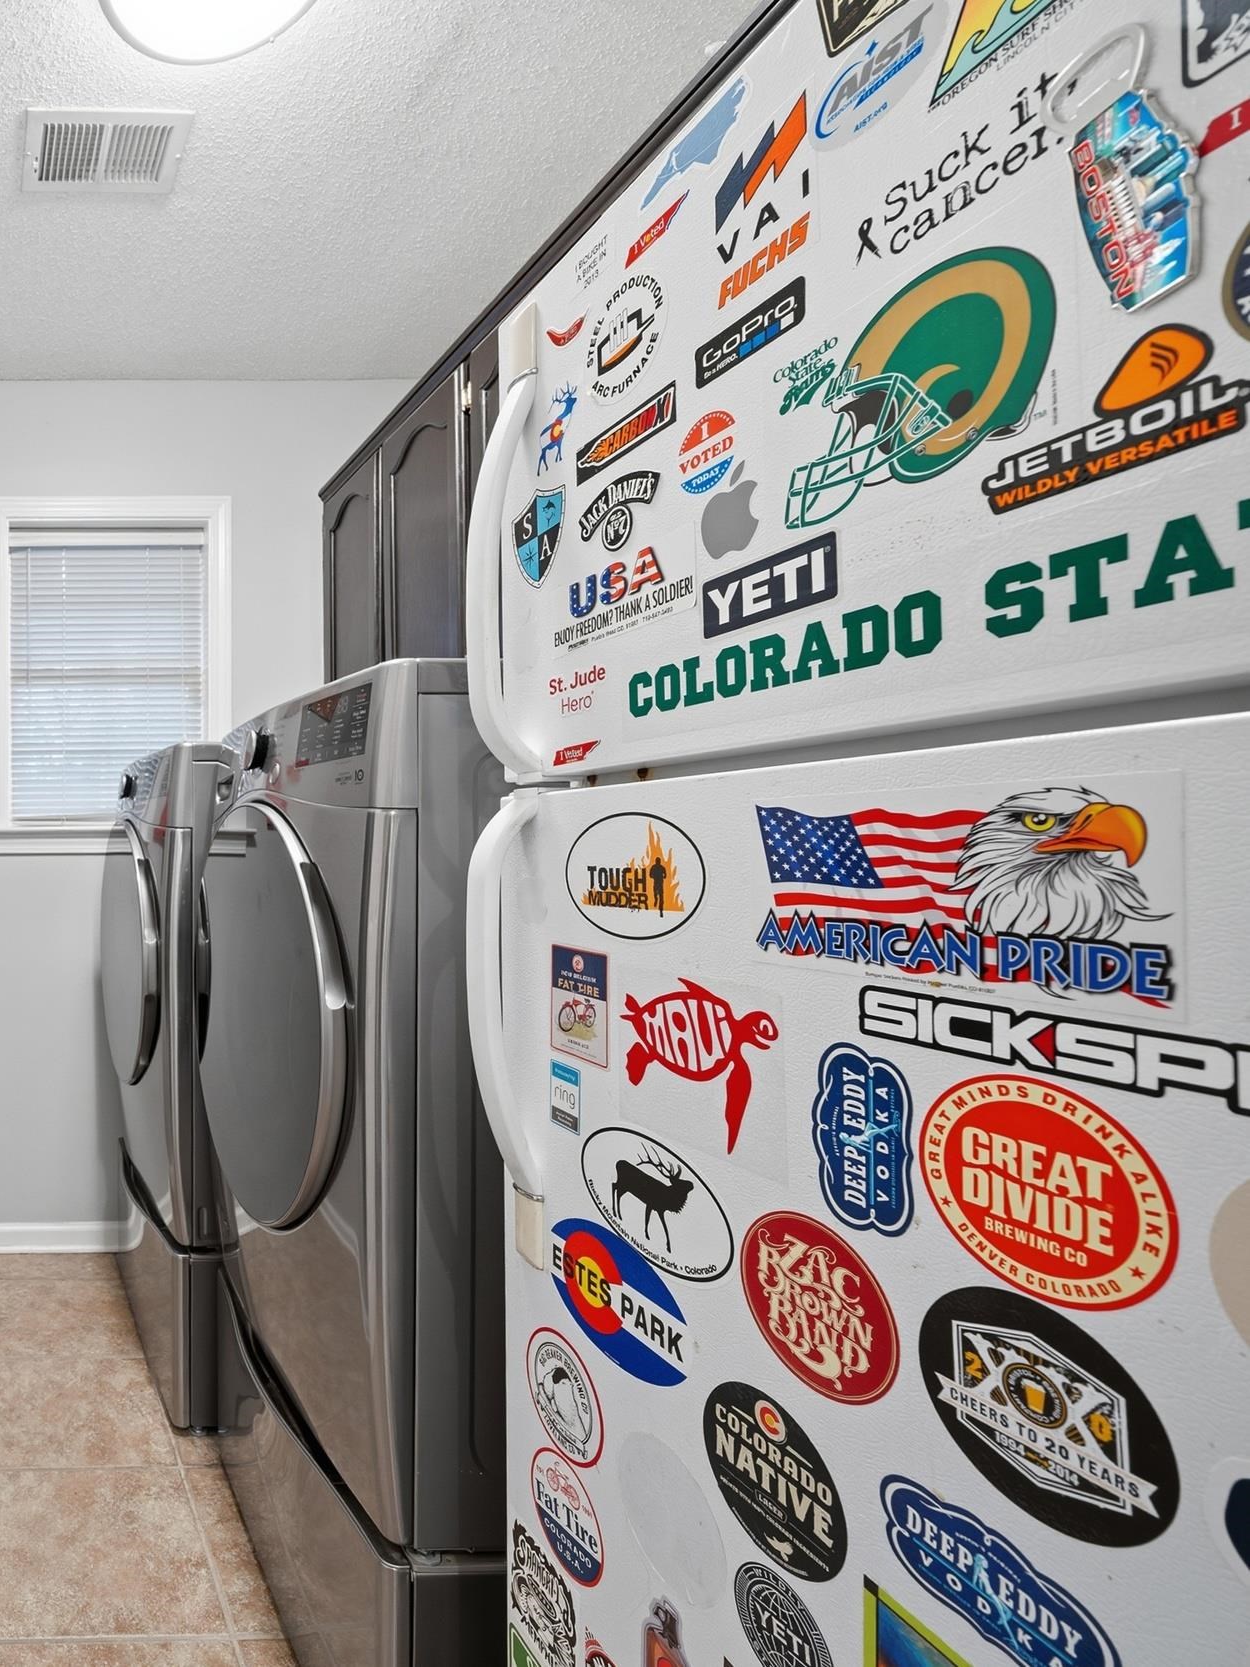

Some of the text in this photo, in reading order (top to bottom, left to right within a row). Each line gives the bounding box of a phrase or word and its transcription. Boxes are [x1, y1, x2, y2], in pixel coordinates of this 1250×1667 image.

[941, 53, 999, 106] OREGON
[1000, 15, 1040, 57] SURF
[996, 0, 1084, 72] LINCOLN CIT
[883, 123, 990, 226] Suck
[889, 125, 1065, 255] cancer.
[640, 217, 665, 248] Voted
[1071, 139, 1135, 300] BOSTON
[717, 211, 811, 310] FUCHS
[587, 274, 663, 369] STEEL PRODUCTION
[702, 296, 796, 368] GoPro
[592, 380, 610, 398] ARC
[611, 332, 660, 397] FURNACE
[773, 336, 838, 383] Colorado
[788, 357, 823, 388] State
[679, 435, 734, 475] VOTED
[700, 421, 710, 440] I
[987, 382, 1240, 489] JETBOIL
[994, 408, 1238, 508] WILDLY VERSATILE
[691, 465, 722, 488] TODAY
[522, 512, 533, 540] S
[540, 534, 553, 560] A
[579, 495, 609, 538] JACK
[554, 624, 575, 648] ENJOY
[575, 609, 614, 640] FREEDOM?
[614, 600, 643, 624] THANK
[644, 596, 652, 612] A
[652, 575, 694, 608] SOLDIER!
[569, 546, 664, 618] USA
[628, 499, 1250, 718] COLORADO STA
[707, 547, 826, 625] YETI
[549, 665, 606, 695] St. Jude
[561, 693, 593, 714] Hero
[587, 865, 647, 893] TOUGH
[588, 890, 649, 911] MUDDER
[558, 977, 600, 998] FAT TIRE
[755, 909, 1174, 1000] AMERICAN PRIDE
[864, 989, 1250, 1109] SICKSP
[554, 1084, 576, 1110] ring
[842, 1066, 866, 1208] DEEP EDDY
[875, 1086, 890, 1203] VODKA
[928, 1109, 952, 1180] GREAT
[951, 1084, 1030, 1111] MINDS
[1042, 1091, 1134, 1160] DRINK
[1129, 1170, 1164, 1258] ALIKE
[961, 1126, 1114, 1201] GREAT
[602, 1205, 630, 1240] Mountain
[630, 1236, 660, 1261] National
[660, 1256, 679, 1271] Park
[684, 1263, 717, 1276] Colorado
[961, 1166, 1114, 1257] DIVIDE
[984, 1215, 1087, 1268] BREWING CO
[957, 1222, 1123, 1299] DENVER COLORADO
[552, 1243, 684, 1364] ESTES PARK
[563, 1358, 586, 1400] BREWING
[714, 1402, 833, 1507] COLORADO
[949, 1386, 1141, 1499] CHEERS TO 20 YEARS
[994, 1431, 1080, 1487] 1994 2014
[535, 1477, 598, 1554] Fat Tire
[715, 1423, 834, 1549] NATIVE
[758, 1493, 784, 1520] LAGER
[544, 1517, 592, 1568] COLORADO
[905, 1503, 975, 1574] DEEP
[998, 1573, 1083, 1659] EDDY
[753, 1600, 811, 1667] YETI
